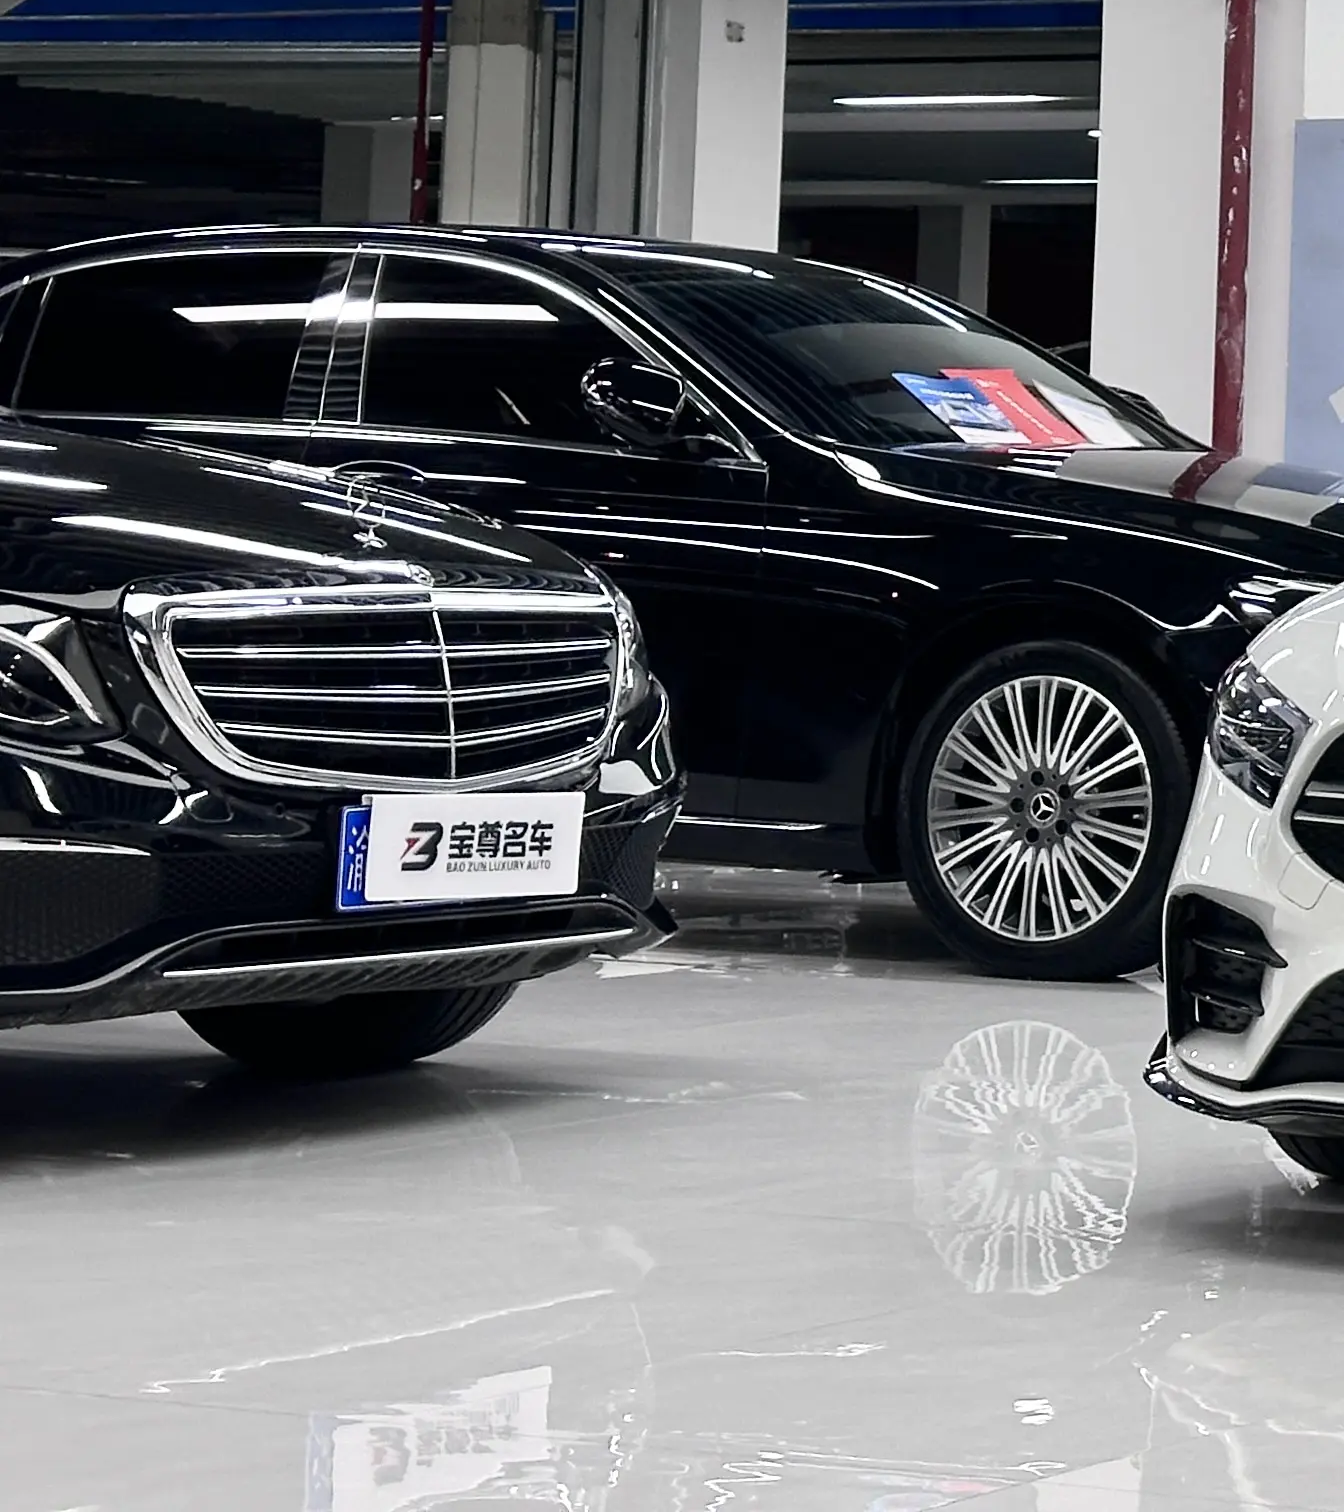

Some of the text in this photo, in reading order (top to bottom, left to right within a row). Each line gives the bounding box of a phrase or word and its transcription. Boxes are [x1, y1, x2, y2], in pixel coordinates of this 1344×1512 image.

[448, 820, 554, 859] 宝尊名车
[446, 859, 551, 873] BAO ZUN LUXURY AUTO
